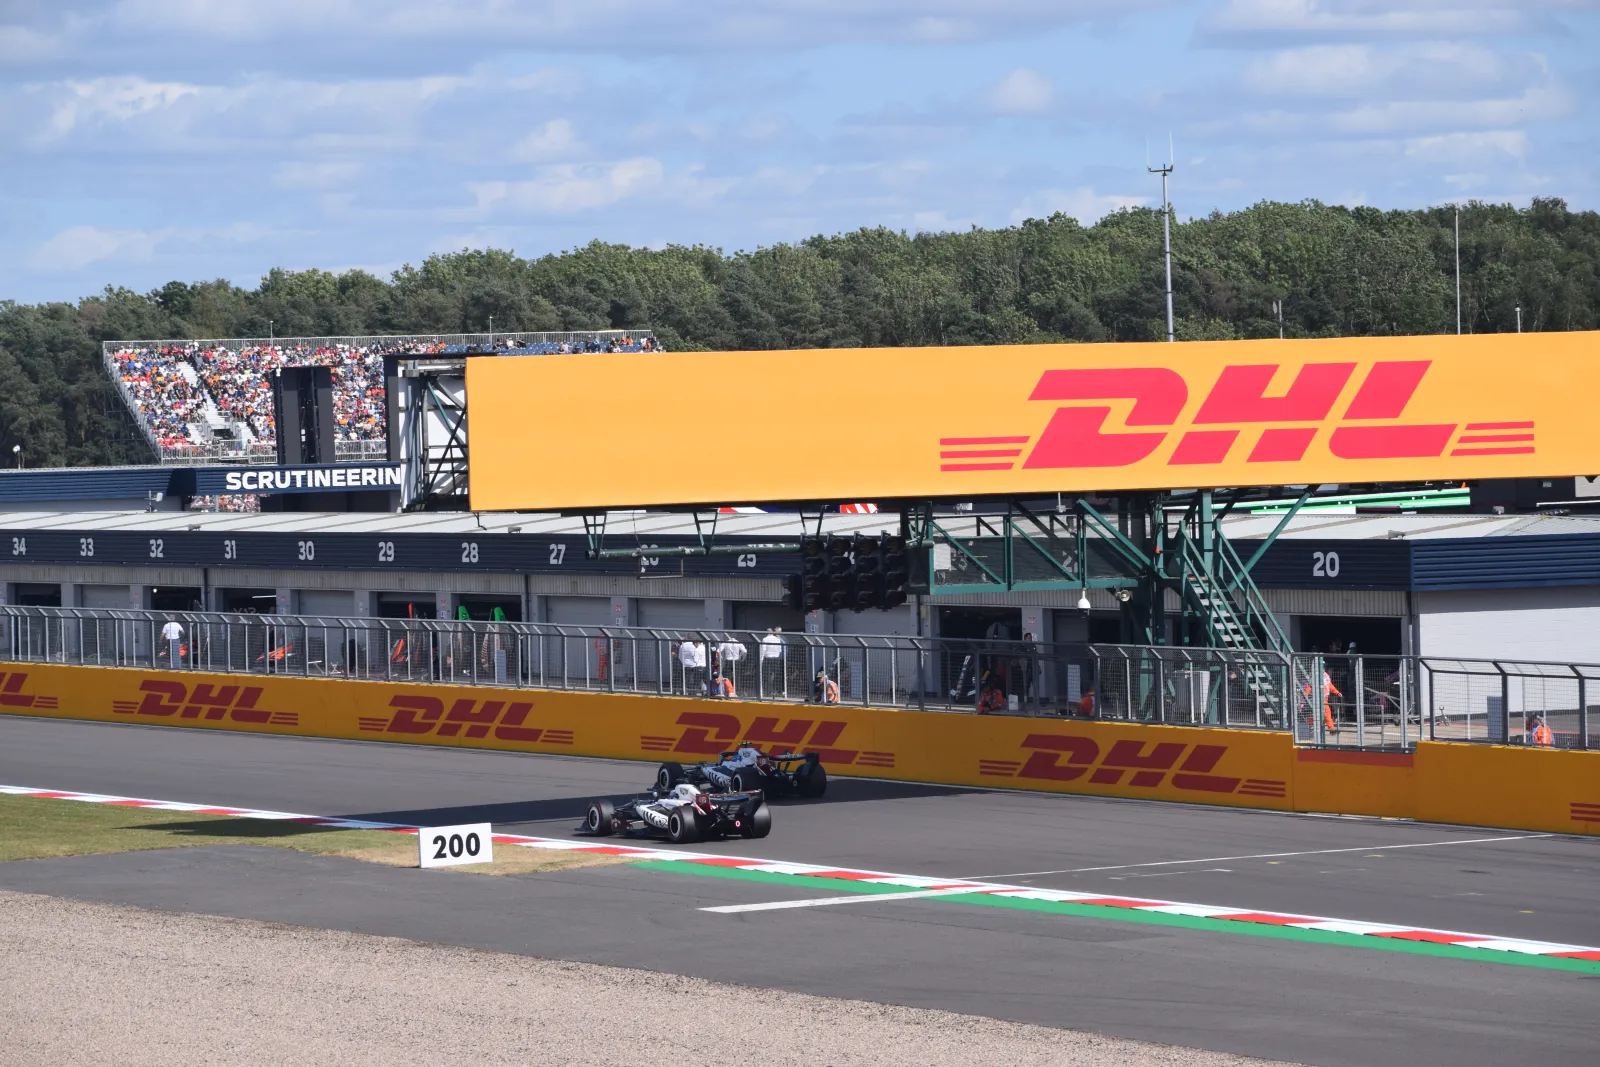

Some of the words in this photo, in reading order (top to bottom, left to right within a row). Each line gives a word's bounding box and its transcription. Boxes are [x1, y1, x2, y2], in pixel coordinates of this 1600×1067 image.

[1021, 360, 1458, 469] DHL
[226, 467, 401, 491] SCRUTINEERIN
[12, 537, 26, 555] 34
[80, 537, 94, 557] 33
[149, 539, 164, 558] 32
[224, 540, 237, 559] 31
[298, 541, 315, 561] 30
[378, 542, 395, 562] 29
[461, 542, 479, 563] 28
[549, 543, 566, 565] 27
[1312, 551, 1340, 577] 20
[136, 679, 272, 724] DHL
[387, 695, 544, 742] DHL
[673, 711, 858, 765] DHL
[1017, 733, 1242, 793] DHL
[432, 832, 481, 860] 200
